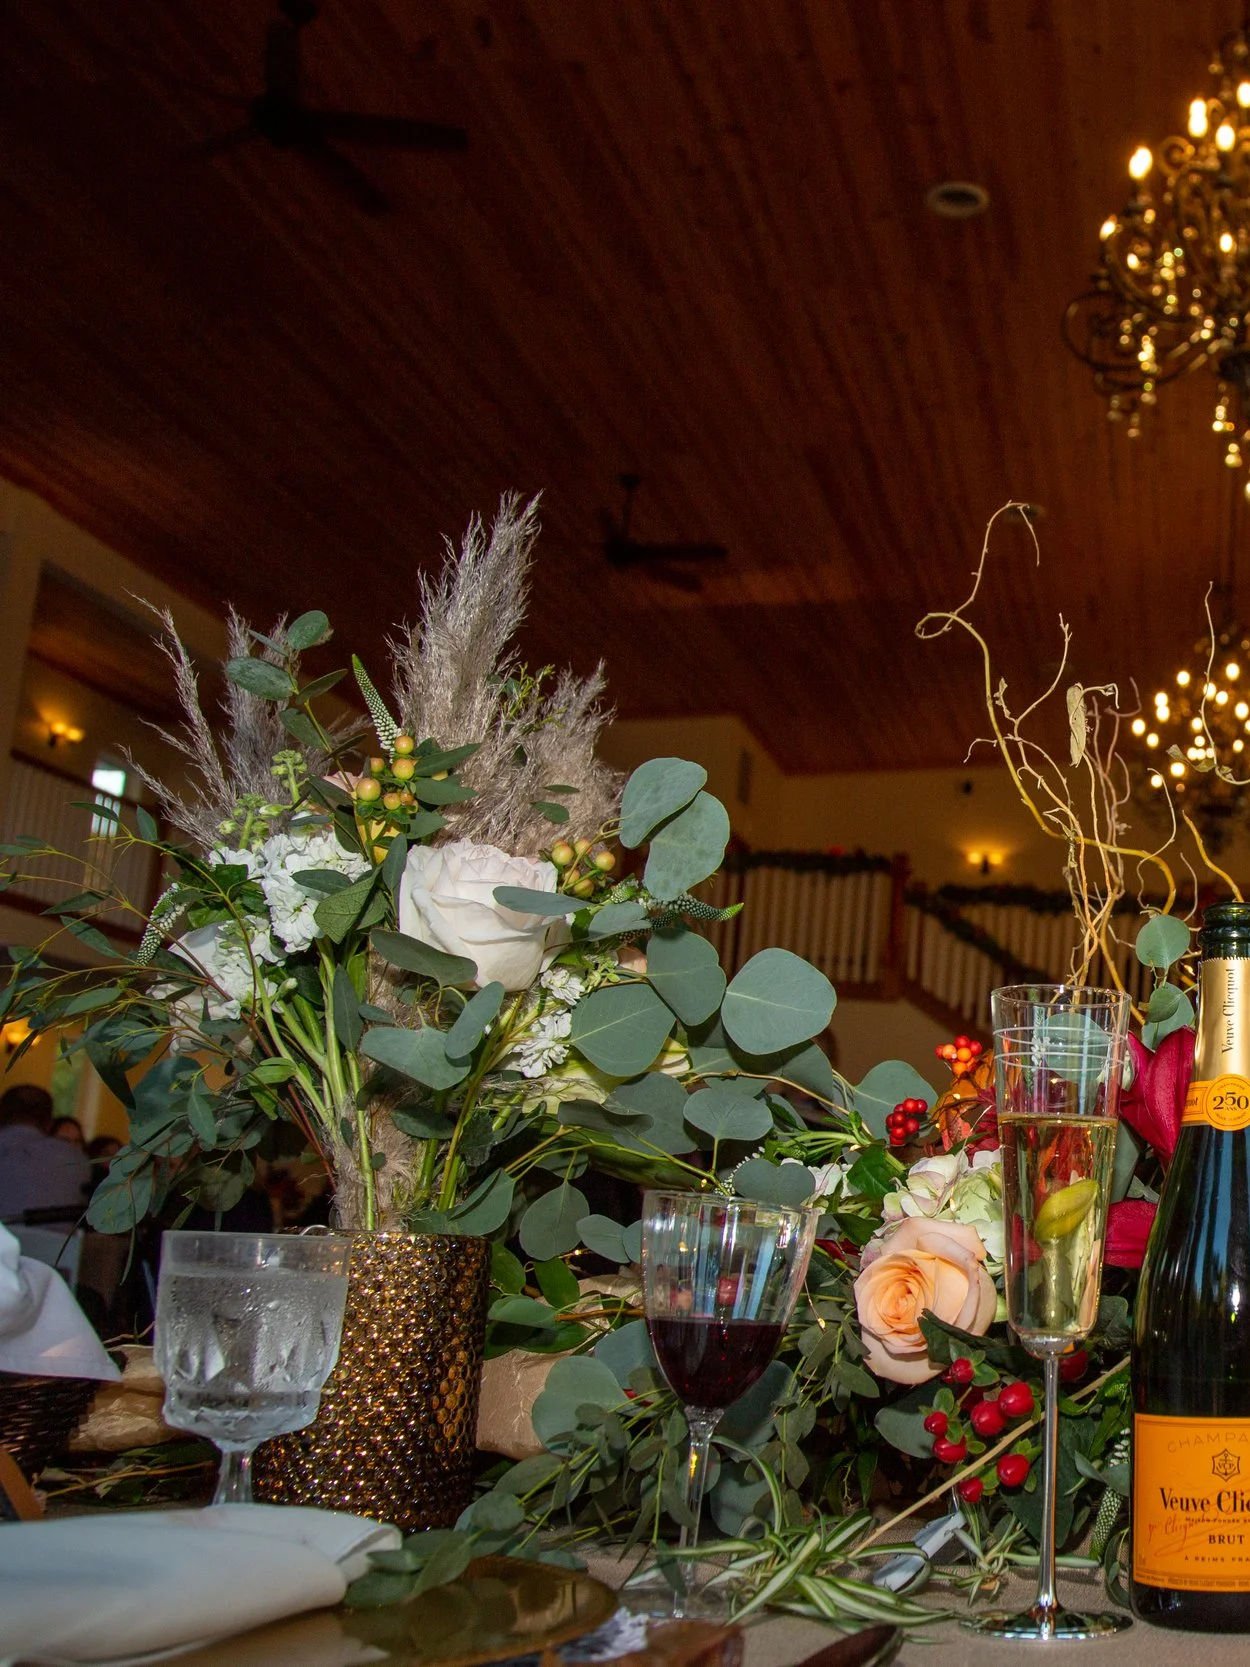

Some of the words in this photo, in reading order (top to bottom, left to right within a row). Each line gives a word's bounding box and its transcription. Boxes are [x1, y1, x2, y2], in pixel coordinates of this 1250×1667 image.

[1221, 968, 1238, 1017] Clicquot
[1221, 1020, 1235, 1054] Veuve
[1212, 1092, 1250, 1110] 250
[1159, 1487, 1211, 1512] Veuve
[1208, 1534, 1245, 1545] BRUT
